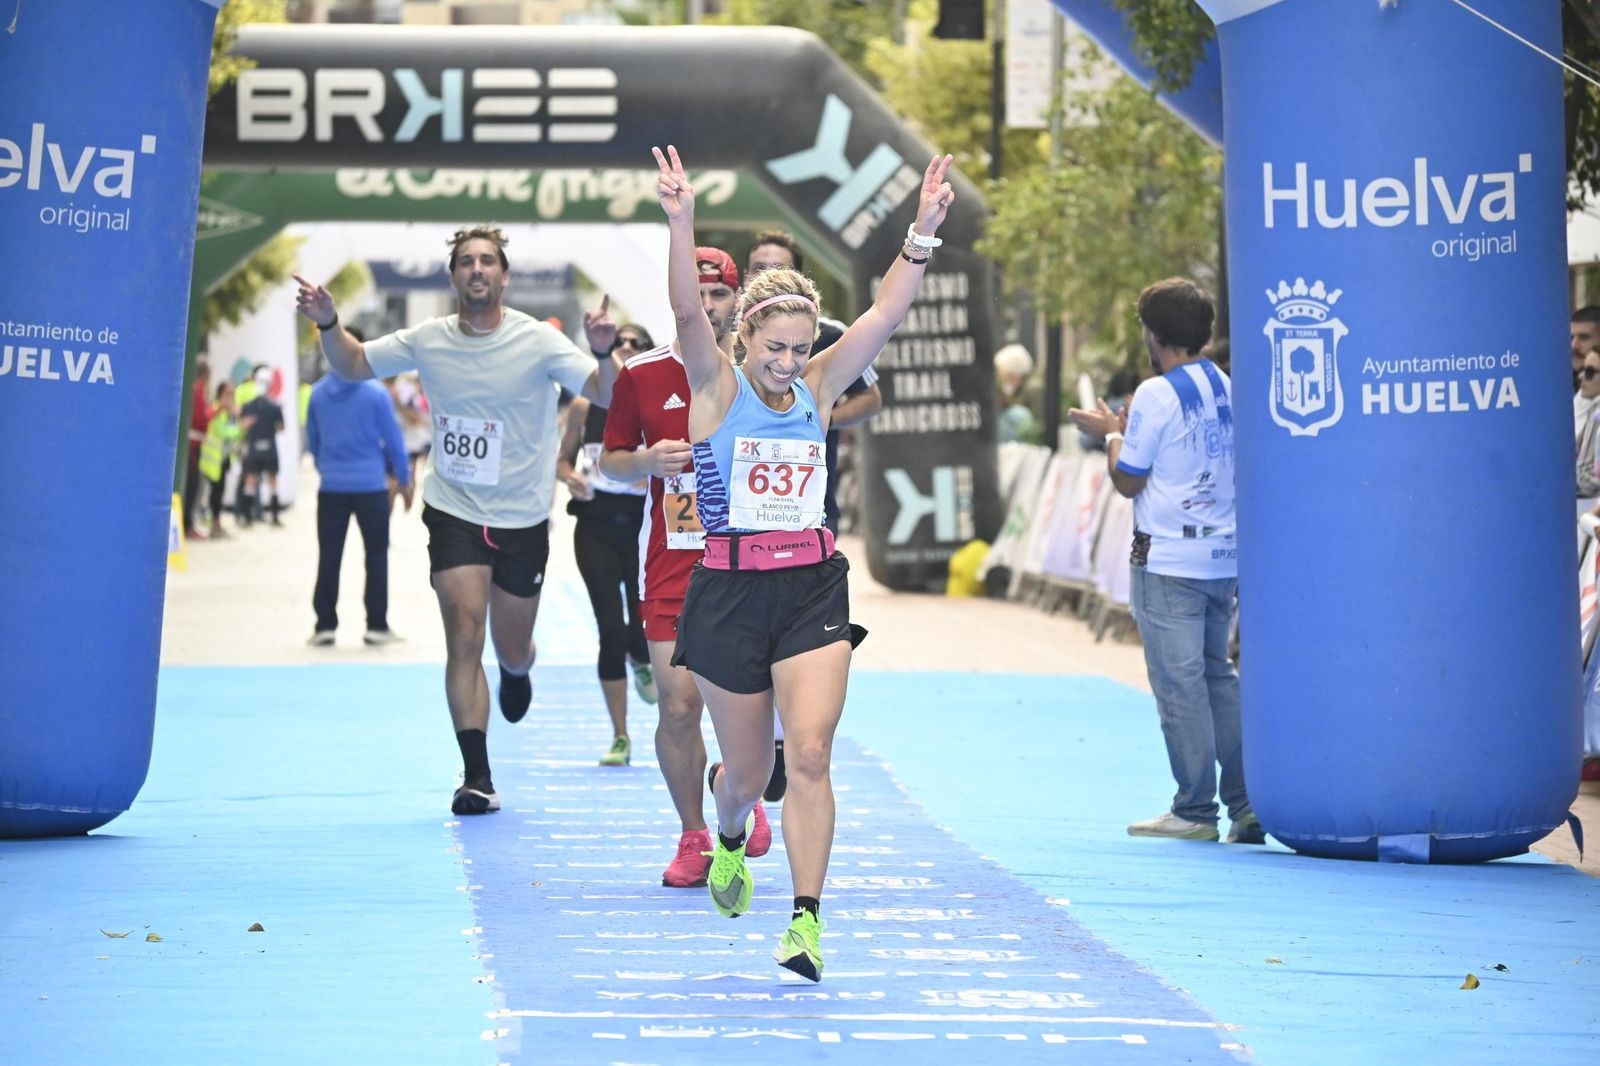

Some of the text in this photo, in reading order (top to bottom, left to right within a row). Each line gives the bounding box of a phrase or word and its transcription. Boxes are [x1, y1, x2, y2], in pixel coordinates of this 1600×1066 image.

[40, 202, 130, 233] original
[1431, 229, 1517, 262] original
[98, 326, 119, 344] de
[1362, 350, 1520, 379] Ayuntamiento de
[1362, 377, 1520, 415] HUELVA
[443, 432, 488, 460] 680
[748, 463, 815, 497] 637
[756, 510, 801, 523] Huelva
[768, 541, 815, 551] LURBEL
